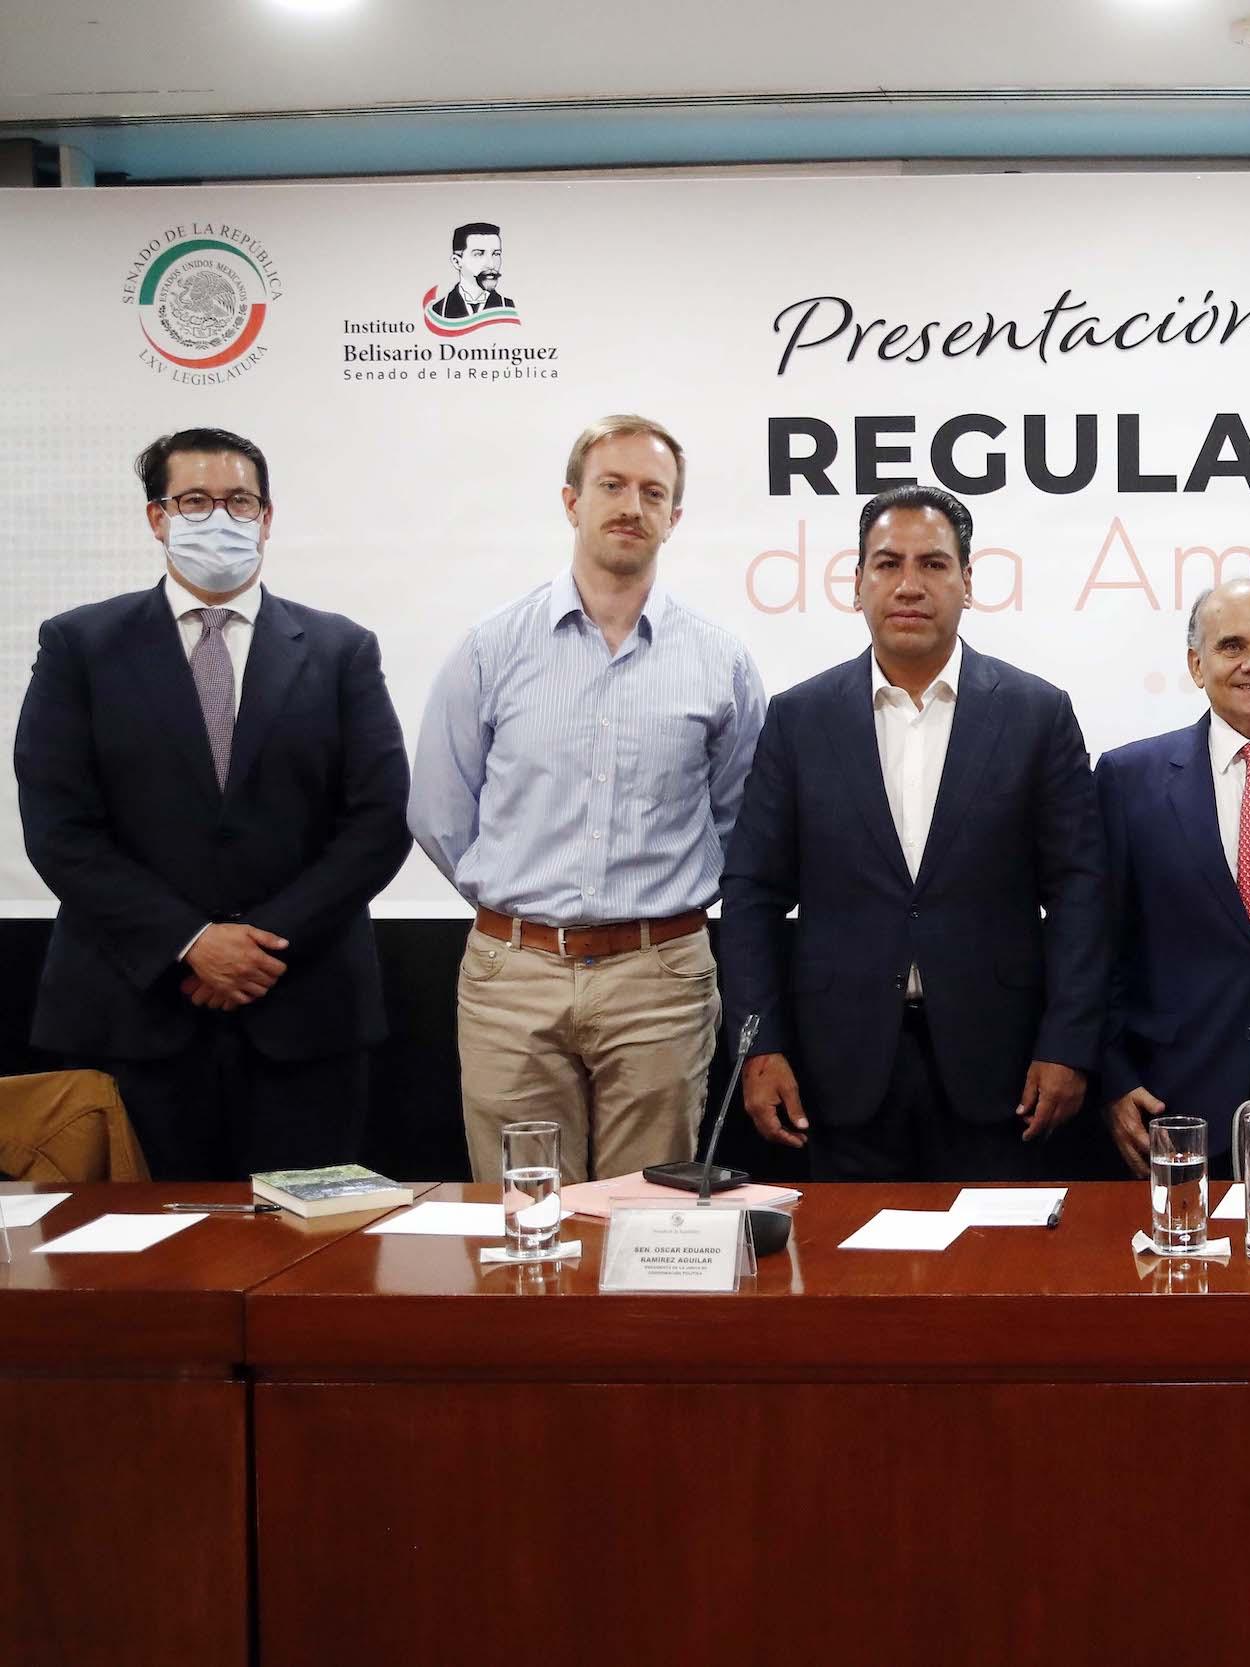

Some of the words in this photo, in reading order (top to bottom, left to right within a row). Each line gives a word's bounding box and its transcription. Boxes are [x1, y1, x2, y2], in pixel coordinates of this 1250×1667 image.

[123, 239, 161, 304] SENADO
[165, 225, 187, 243] DE
[193, 223, 214, 235] LA
[220, 224, 283, 301] REPÚBLICA
[182, 260, 213, 272] UNIDOS
[344, 319, 415, 334] Instituto
[343, 344, 432, 362] Belisario
[439, 343, 559, 365] Domínguez
[139, 349, 167, 373] LXV
[172, 345, 268, 385] LEGISLATURA
[344, 369, 408, 381] Senado
[418, 368, 438, 380] de
[447, 367, 461, 379] la
[468, 367, 559, 381] República
[654, 1246, 681, 1254] OSCAR
[683, 1246, 721, 1254] EDUARDO
[677, 1256, 713, 1264] AGUILAR
